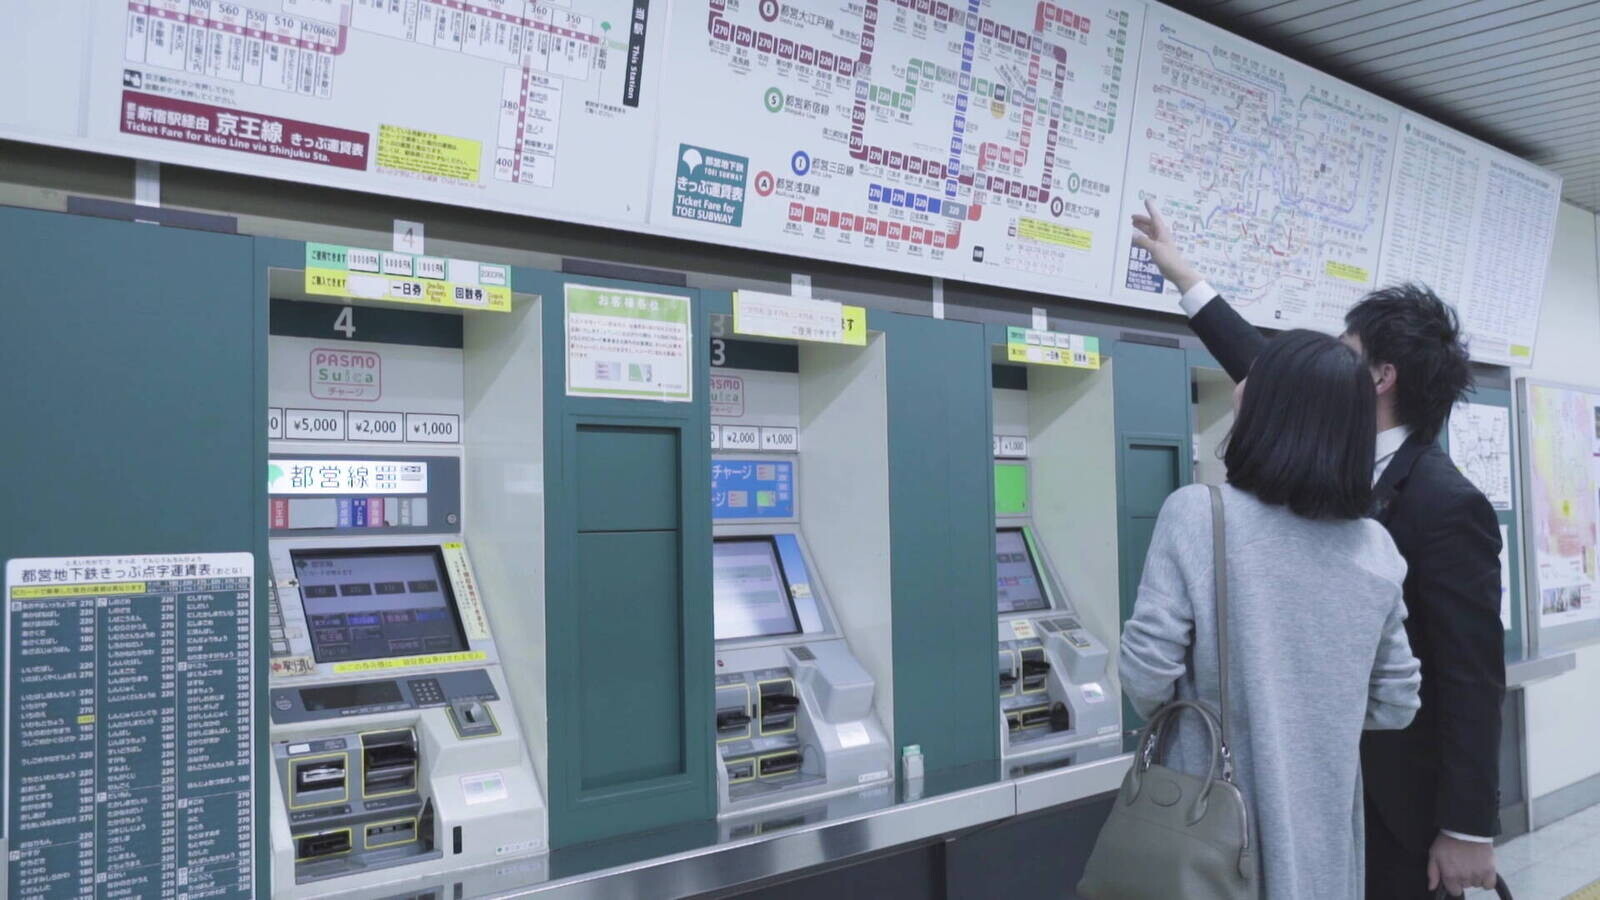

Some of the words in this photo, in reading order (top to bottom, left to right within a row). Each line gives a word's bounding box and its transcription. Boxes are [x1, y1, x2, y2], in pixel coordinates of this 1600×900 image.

[219, 3, 239, 16] 560
[249, 10, 265, 22] 550
[531, 6, 548, 16] 360
[274, 17, 295, 28] 510
[565, 13, 582, 25] 350
[302, 23, 318, 34] 470
[319, 27, 337, 38] 460
[714, 25, 729, 37] 270
[737, 30, 751, 42] 270
[759, 36, 773, 49] 270
[779, 43, 793, 55] 270
[799, 49, 813, 61] 270
[631, 45, 640, 64] This
[627, 67, 638, 99] Station
[502, 99, 518, 110] 380
[137, 106, 210, 131] 新宿駅経由
[216, 112, 284, 144] 京王線
[290, 133, 365, 157] きっぷ運賃表
[126, 121, 159, 136] Ticket
[161, 126, 183, 140] Fare
[186, 130, 202, 143] for
[204, 133, 227, 147] Keio
[229, 137, 250, 150] Line
[252, 142, 268, 152] via
[270, 143, 311, 160] Shinjuku
[312, 151, 331, 163] Sta.
[496, 158, 513, 168] 400
[704, 156, 745, 173] 都営地下鉄
[704, 167, 717, 177] TOEI
[719, 170, 743, 182] SUBWAY
[676, 176, 744, 202] きっぷ運賃表
[677, 195, 701, 208] Ticket
[703, 199, 722, 212] Fare
[723, 203, 736, 214] for
[675, 206, 695, 219] TOEI
[697, 210, 733, 224] SUBWAY
[402, 227, 416, 248] 4
[392, 283, 422, 297] 一日券
[455, 287, 483, 301] 回数券
[333, 306, 356, 338] 4
[712, 339, 726, 366] 3
[316, 353, 375, 369] PASMO
[318, 367, 373, 383] Suica
[294, 418, 337, 432] ¥5,000
[355, 420, 397, 434] ¥2,000
[413, 422, 452, 435] ¥1,000
[727, 432, 755, 444] ¥2,000
[766, 434, 793, 445] ¥1,000
[291, 464, 370, 489] 都営線
[712, 464, 752, 480] チャージ
[21, 563, 212, 584] 都営地下鉄きっぷ点字運賃表
